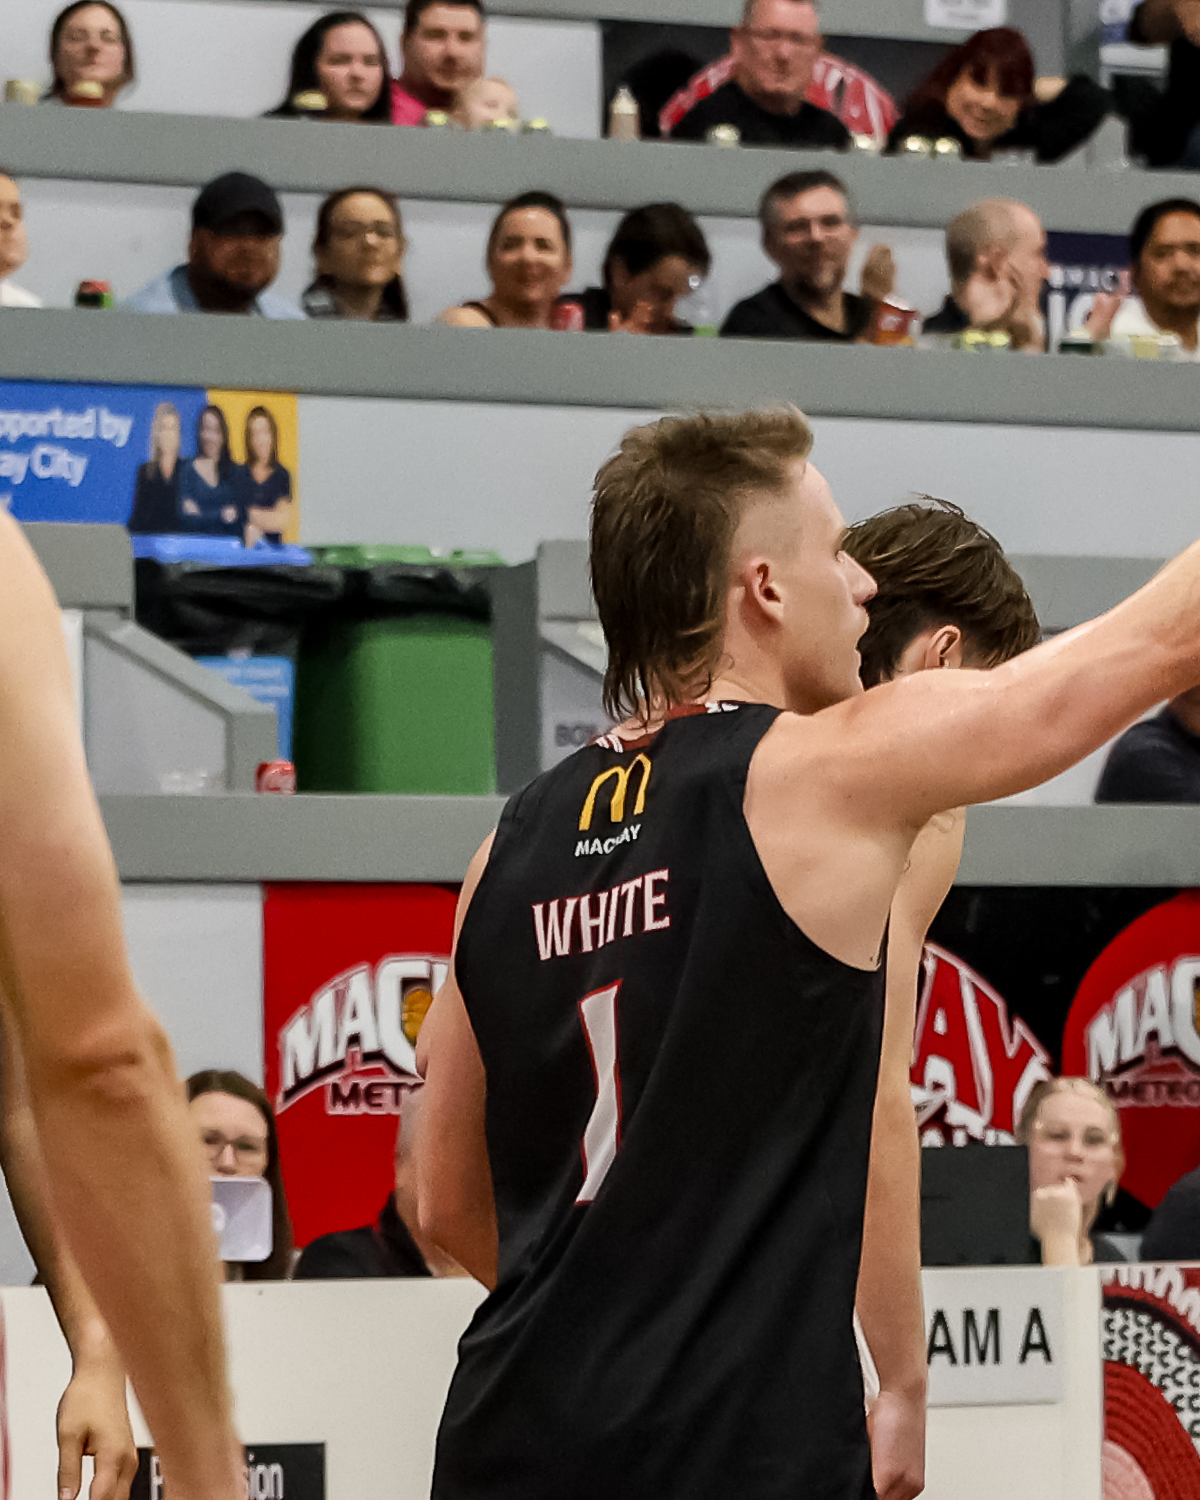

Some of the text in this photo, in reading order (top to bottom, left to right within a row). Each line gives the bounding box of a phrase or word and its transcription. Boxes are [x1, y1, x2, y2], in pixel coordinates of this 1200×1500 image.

[531, 867, 671, 962] WHITE
[282, 957, 450, 1091] MAC
[574, 977, 624, 1206] 1
[1018, 1306, 1053, 1364] A
